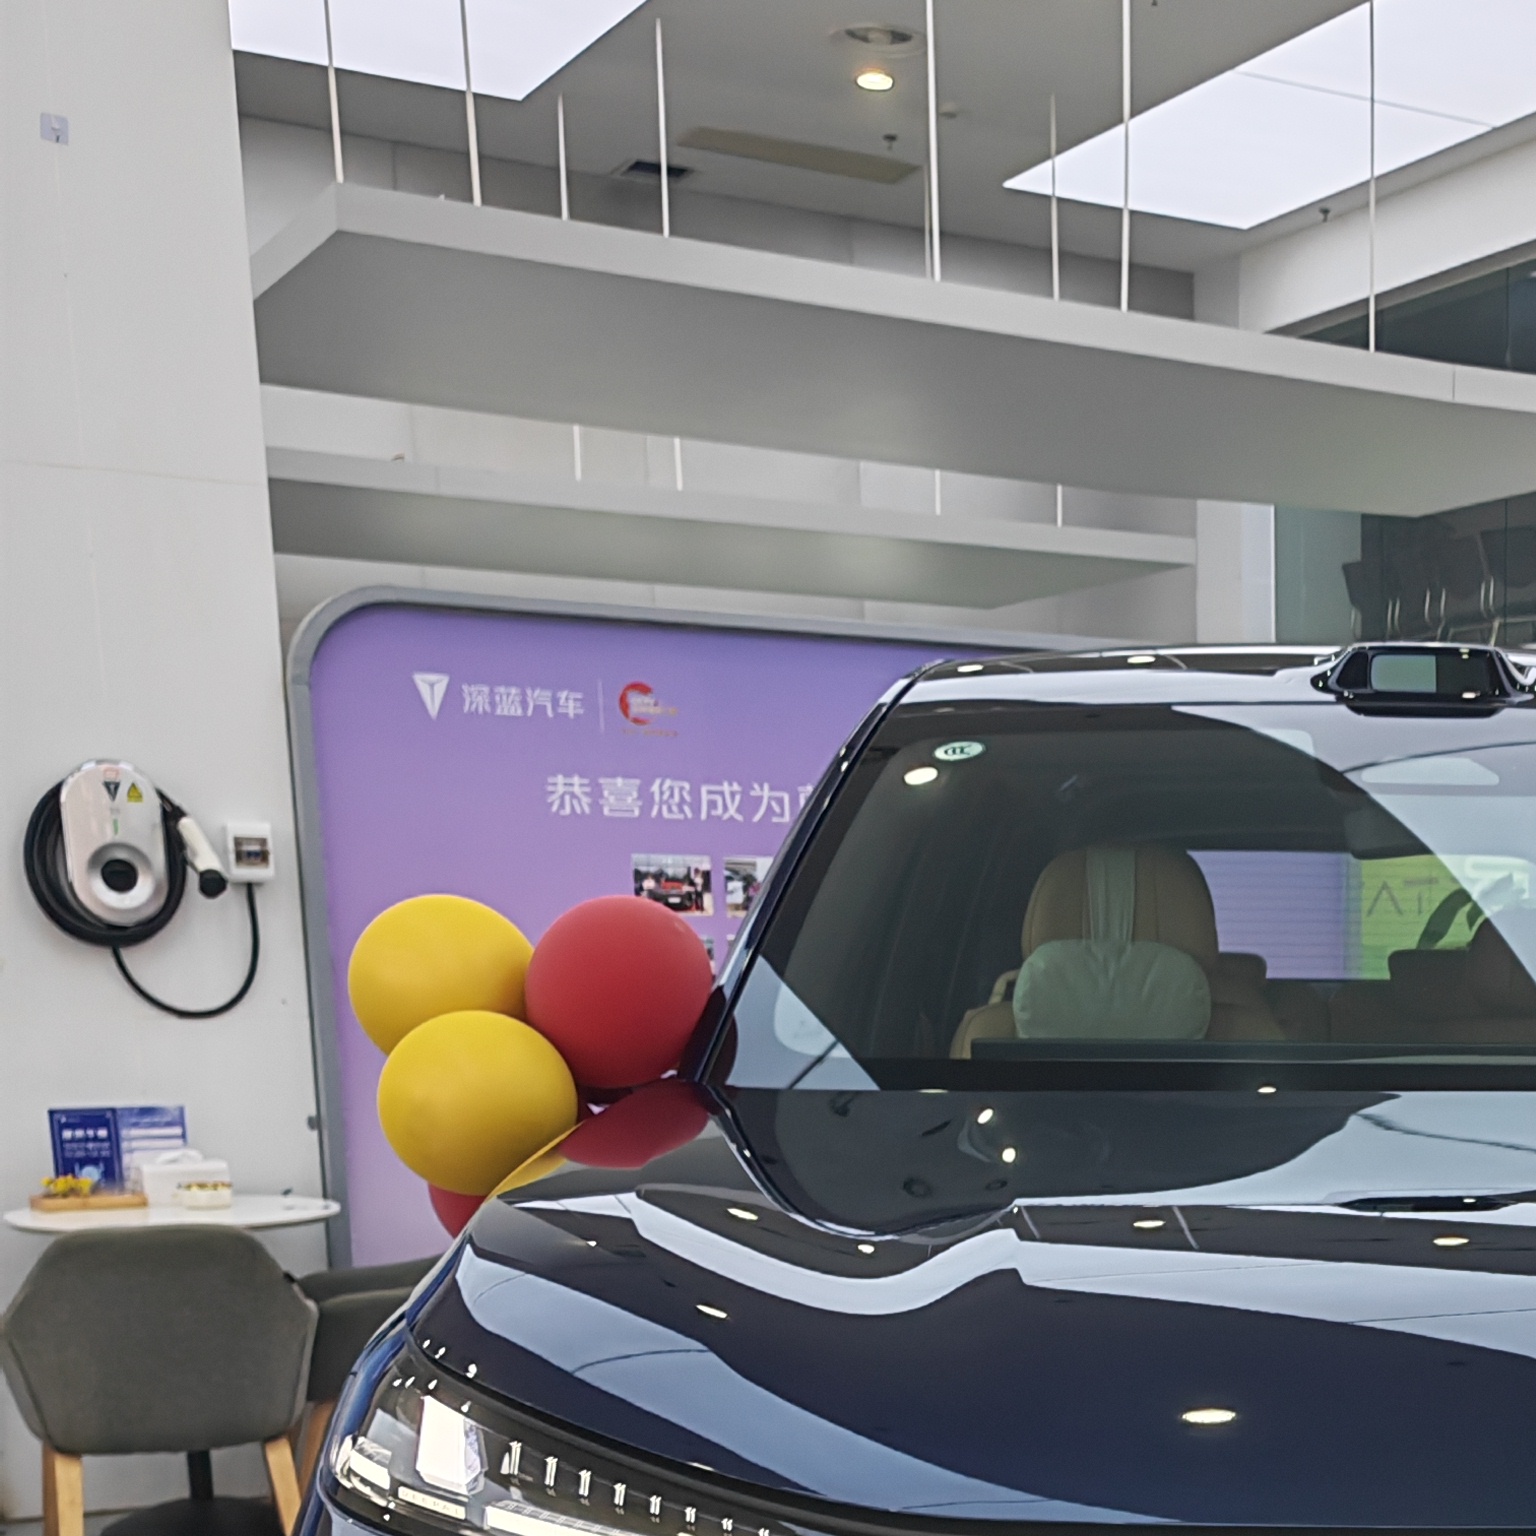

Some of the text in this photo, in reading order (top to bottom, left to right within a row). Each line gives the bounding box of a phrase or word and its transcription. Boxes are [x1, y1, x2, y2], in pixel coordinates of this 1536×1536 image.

[461, 683, 585, 719] 深蓝汽车
[545, 774, 814, 823] 恭喜您成为
